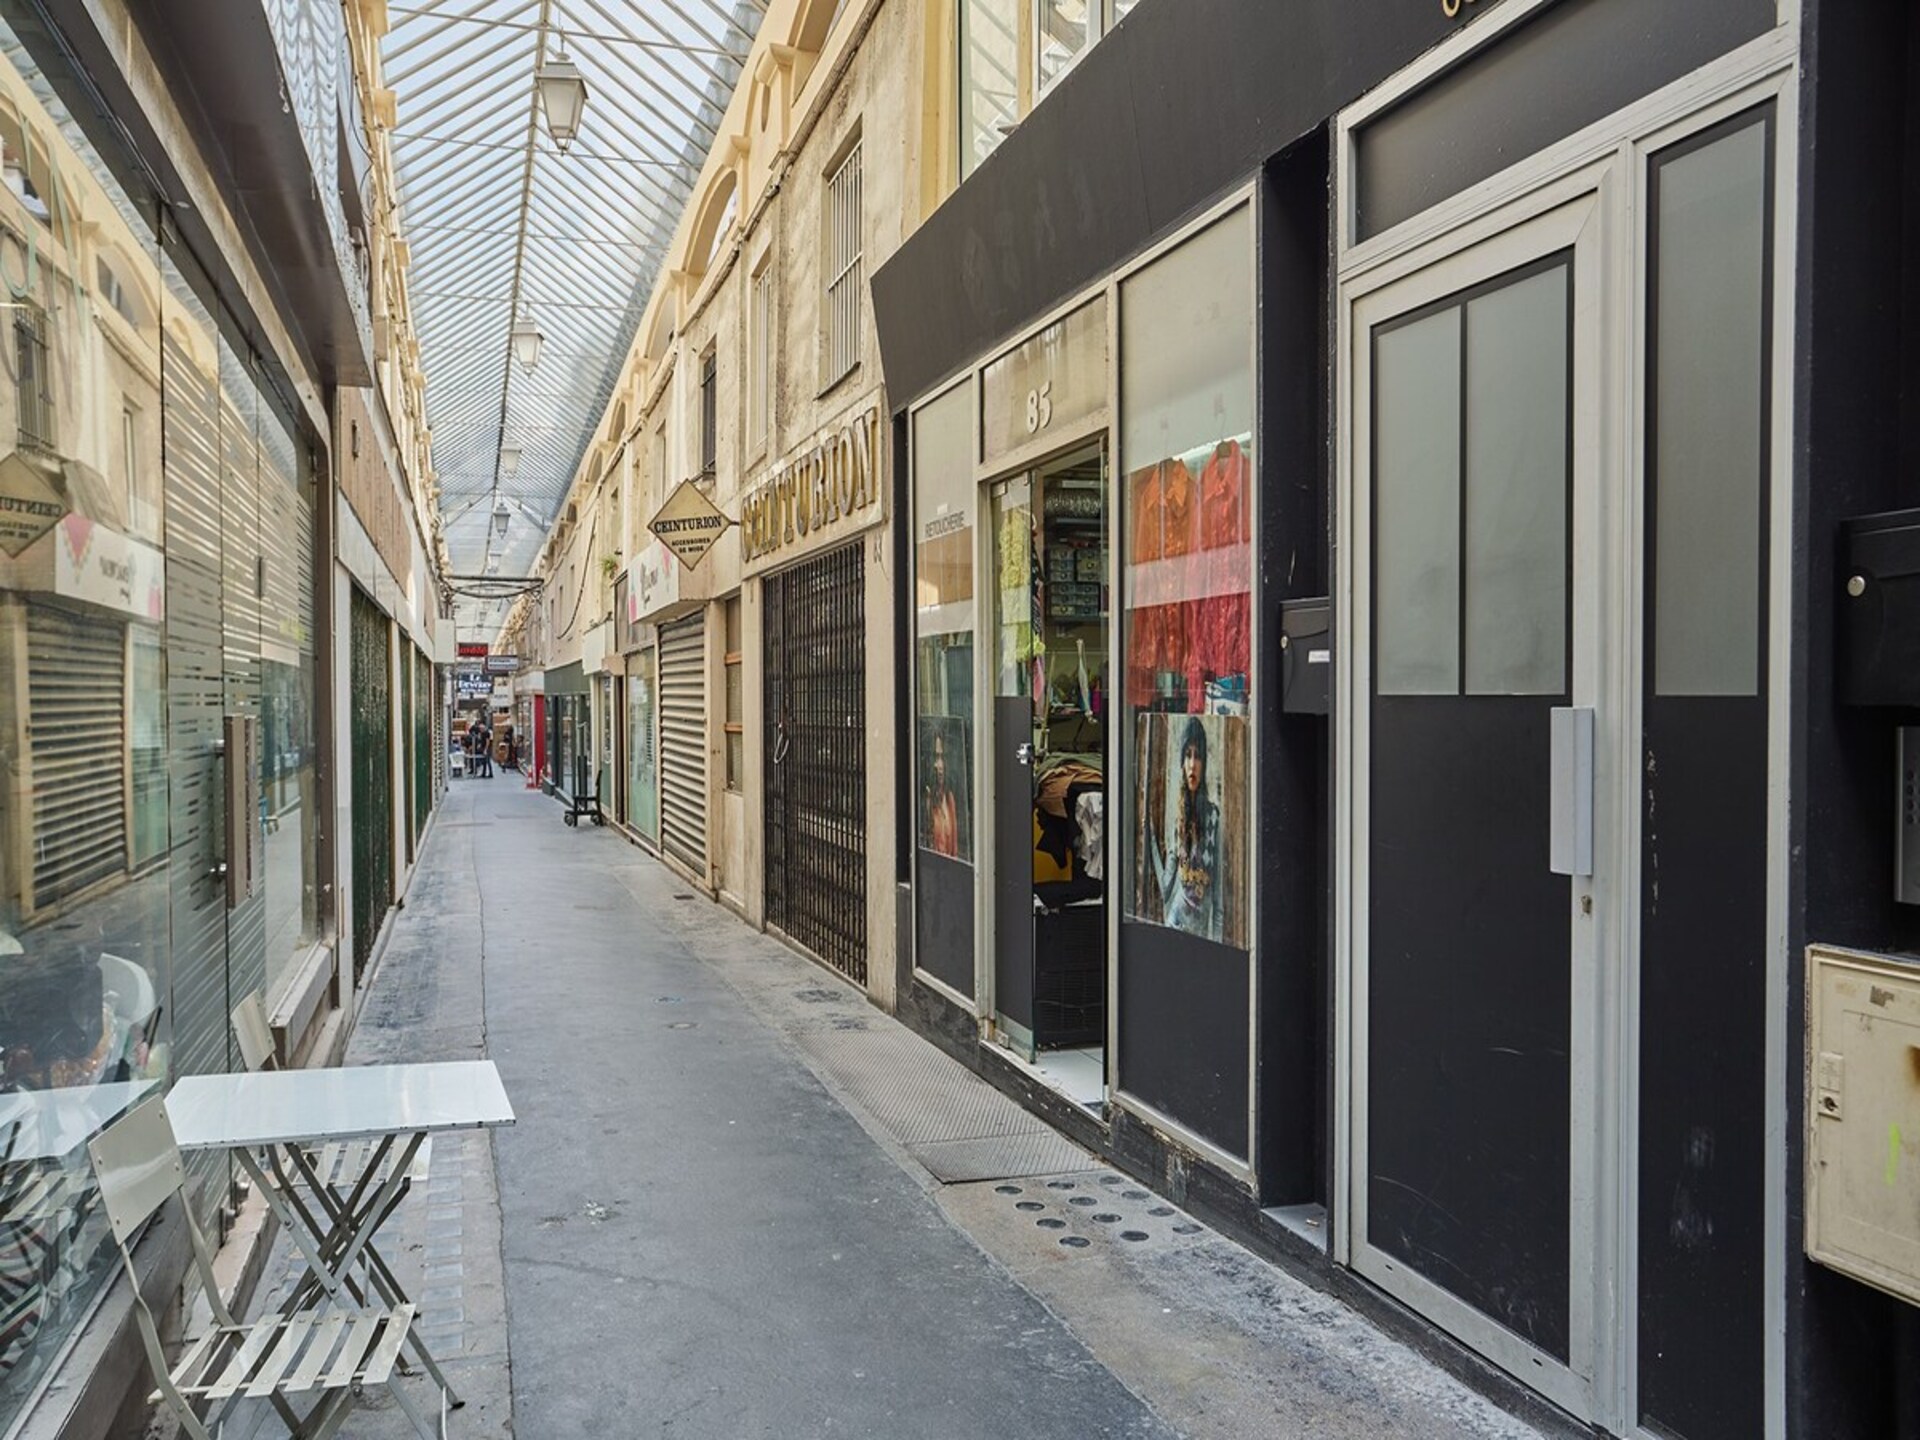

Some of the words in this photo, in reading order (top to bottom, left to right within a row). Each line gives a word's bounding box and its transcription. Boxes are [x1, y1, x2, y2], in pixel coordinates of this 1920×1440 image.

[1026, 380, 1053, 434] 85
[741, 406, 878, 563] CEINTURION
[654, 515, 721, 534] CEINTURION
[925, 510, 965, 537] RETOUCHERIE
